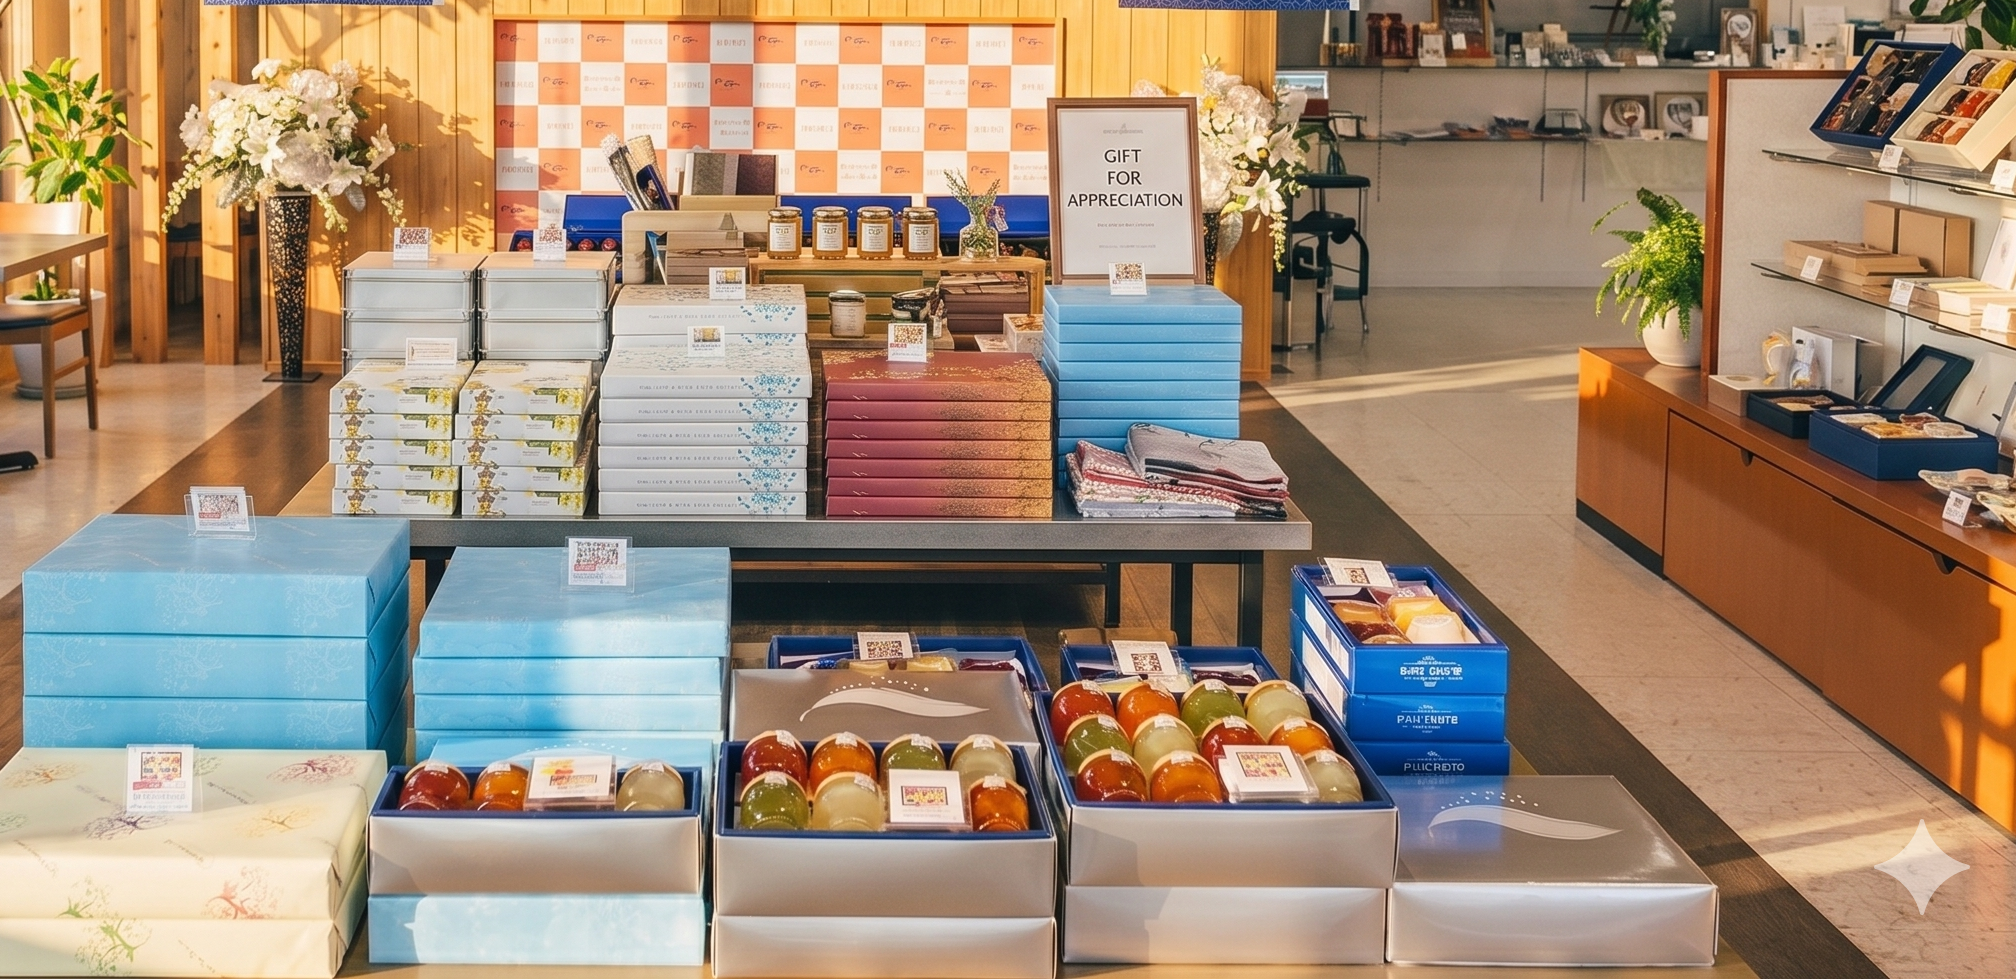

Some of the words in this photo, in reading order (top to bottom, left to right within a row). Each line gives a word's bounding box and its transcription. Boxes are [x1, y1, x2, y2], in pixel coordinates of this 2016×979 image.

[1104, 149, 1142, 163] GIFT
[1107, 170, 1142, 186] FOR
[1067, 193, 1183, 207] APPRECIATION
